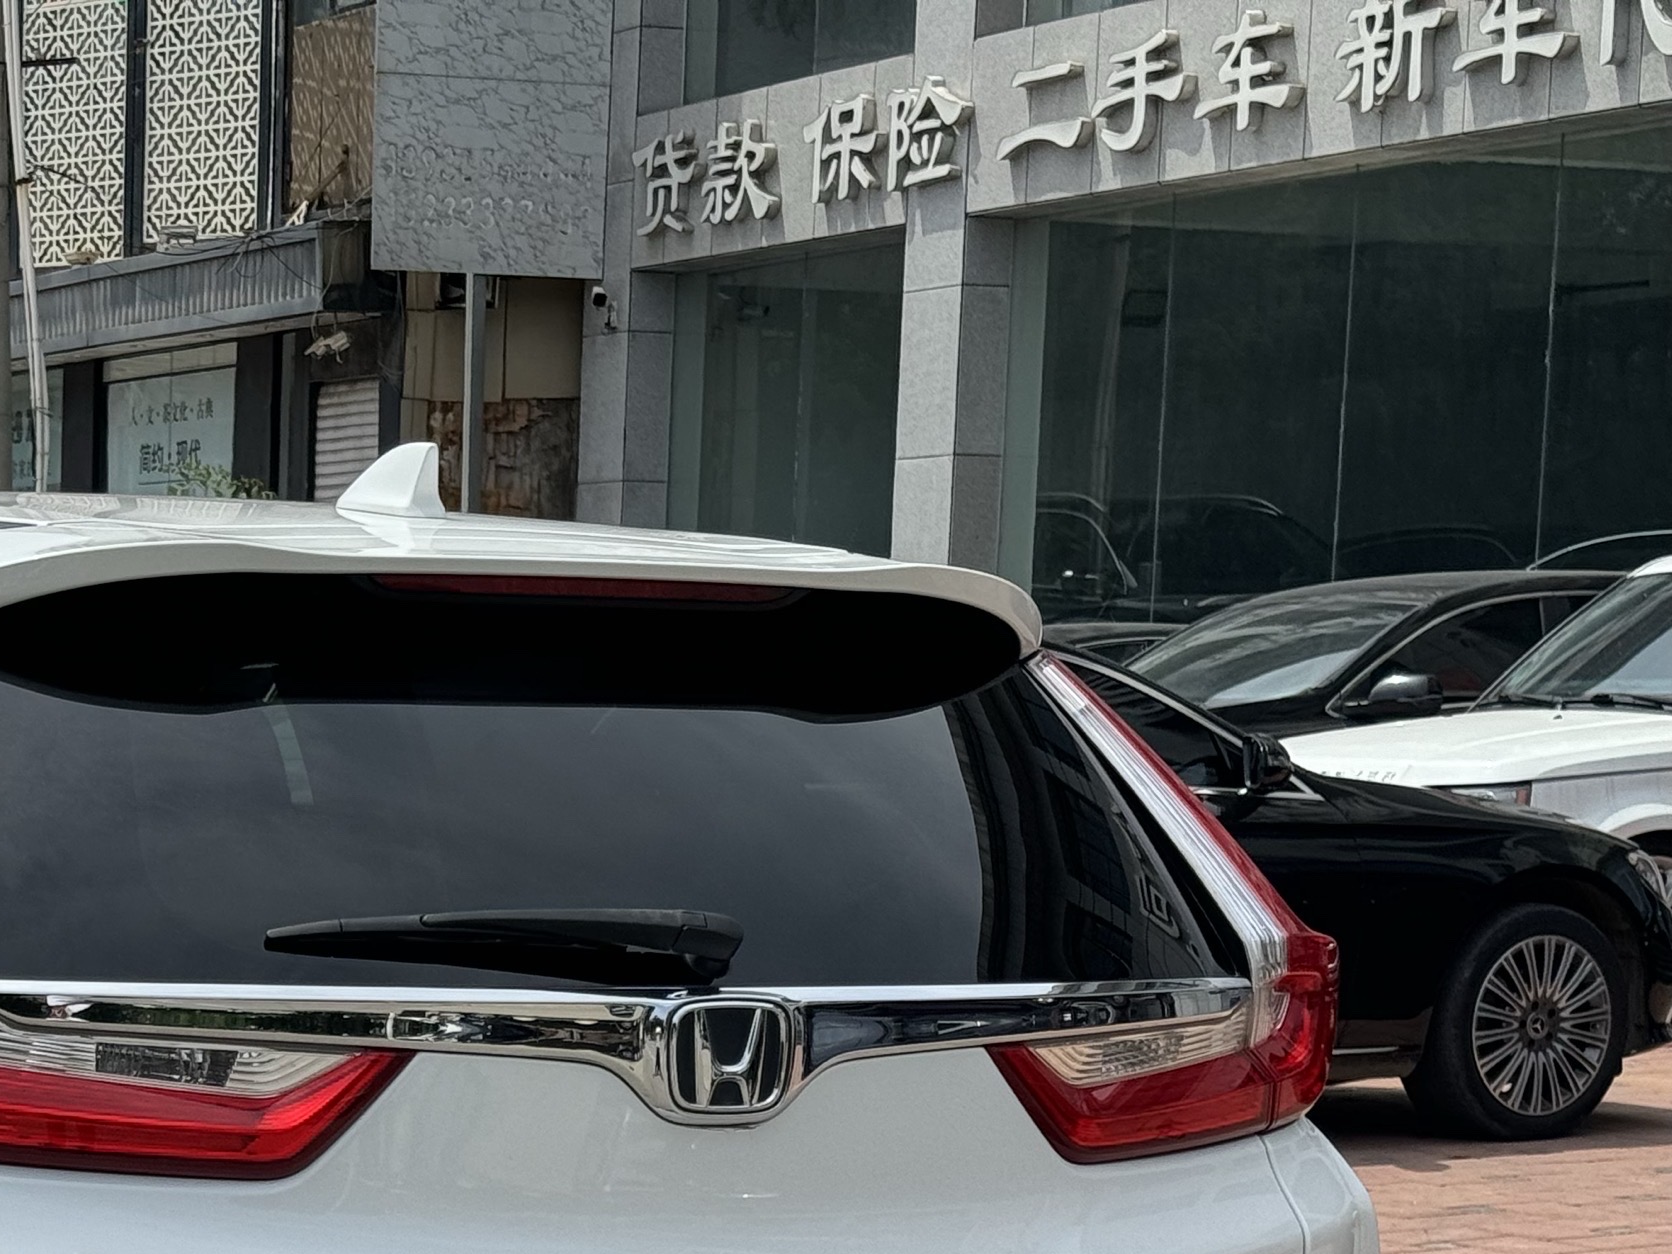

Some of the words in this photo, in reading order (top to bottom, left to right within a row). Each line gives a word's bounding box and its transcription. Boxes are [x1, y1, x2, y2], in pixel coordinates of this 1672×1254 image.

[631, 119, 781, 237] 贷款
[803, 76, 975, 205] 保险
[997, 9, 1307, 161] 二手车
